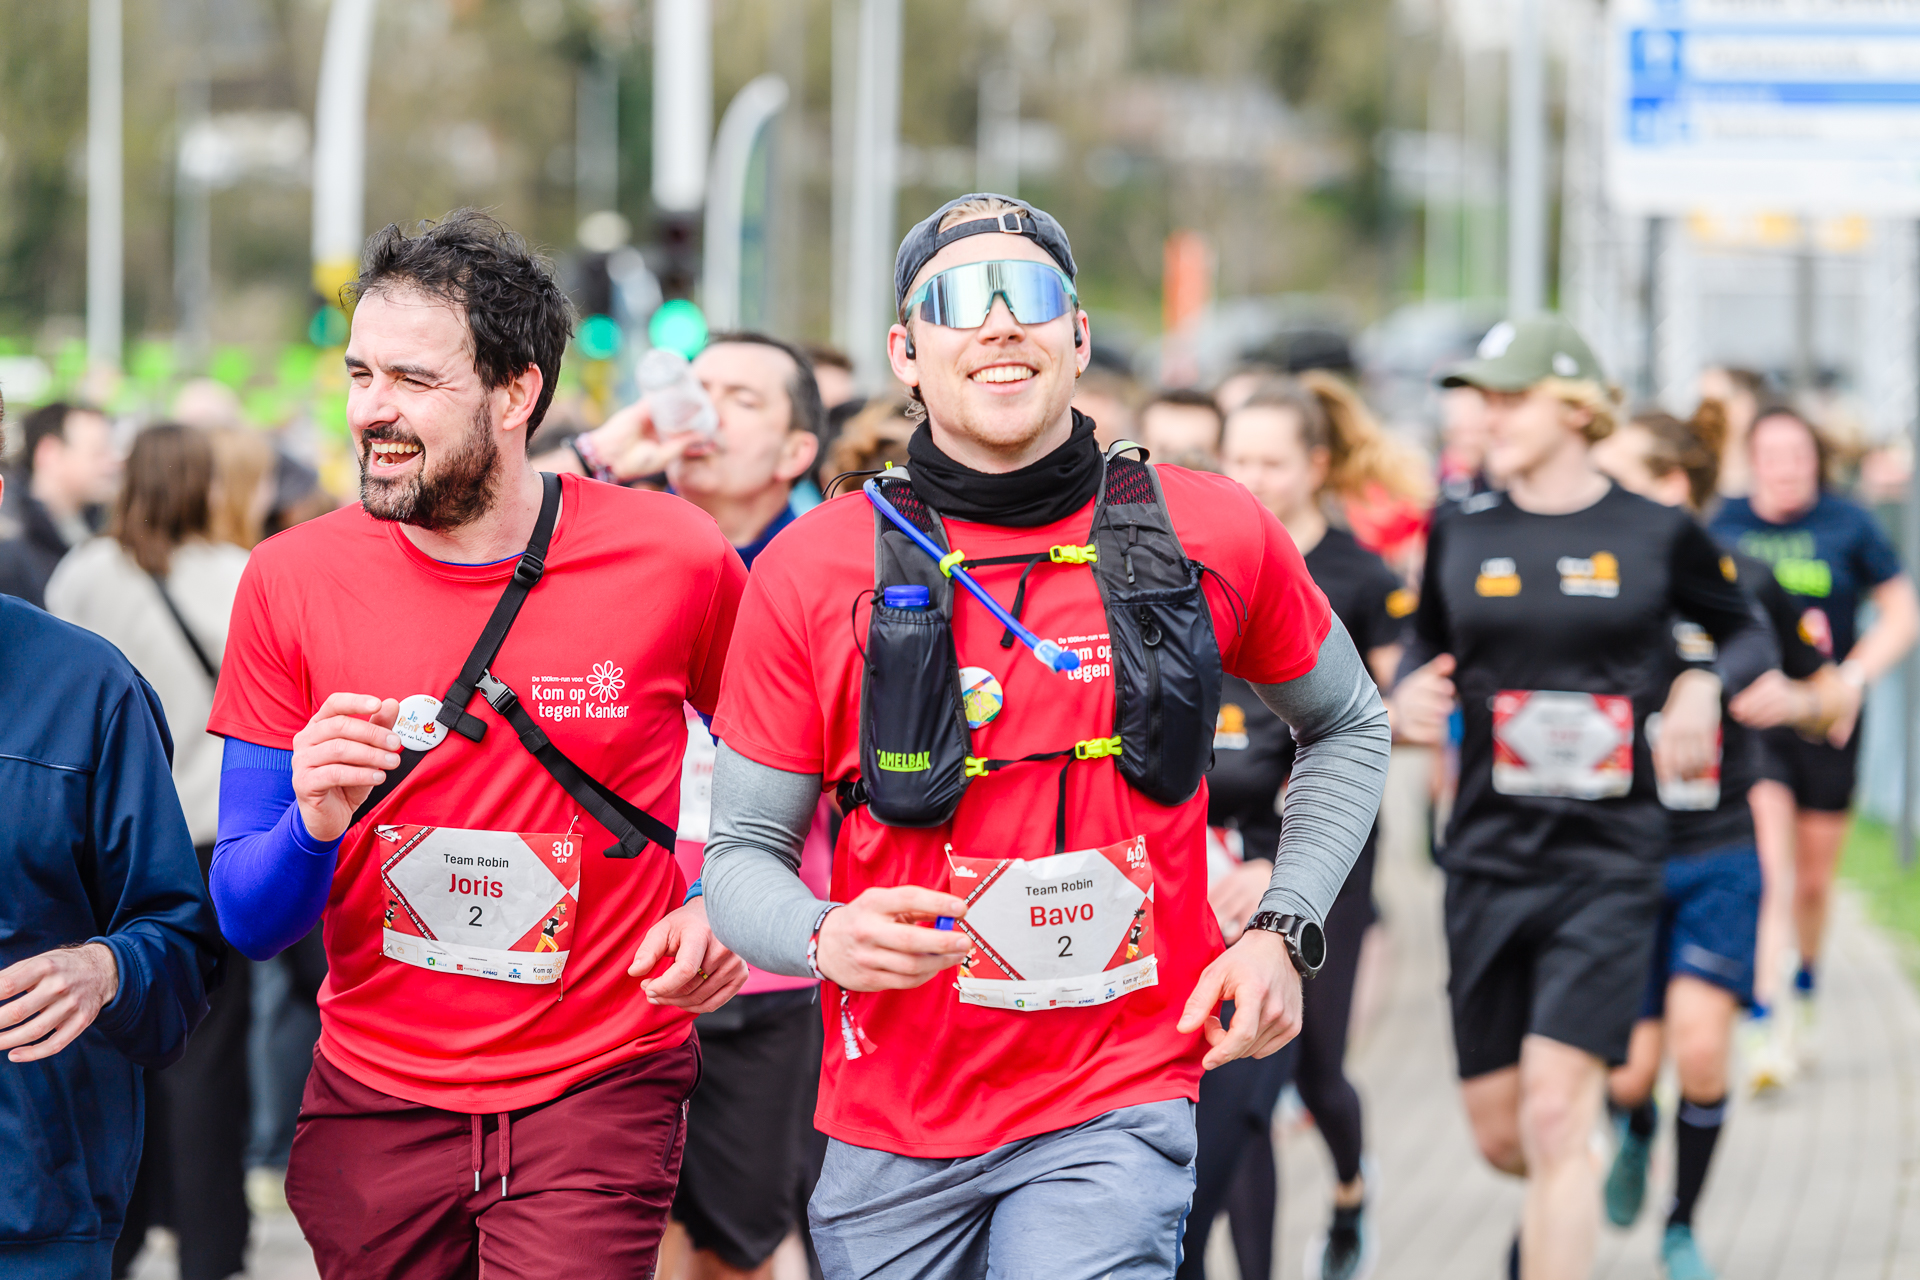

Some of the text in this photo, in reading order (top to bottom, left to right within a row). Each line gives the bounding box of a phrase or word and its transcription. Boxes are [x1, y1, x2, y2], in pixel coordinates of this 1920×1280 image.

[532, 684, 586, 704] Kom op
[538, 702, 629, 722] tegen Kanker
[551, 841, 574, 857] 30
[1126, 844, 1144, 862] 40
[443, 853, 509, 868] Team Robin
[448, 873, 503, 898] Joris
[1025, 878, 1093, 896] Team Robin
[468, 905, 483, 927] 2
[1030, 903, 1094, 927] Bavo
[1057, 935, 1073, 958] 2
[532, 966, 546, 974] Kom
